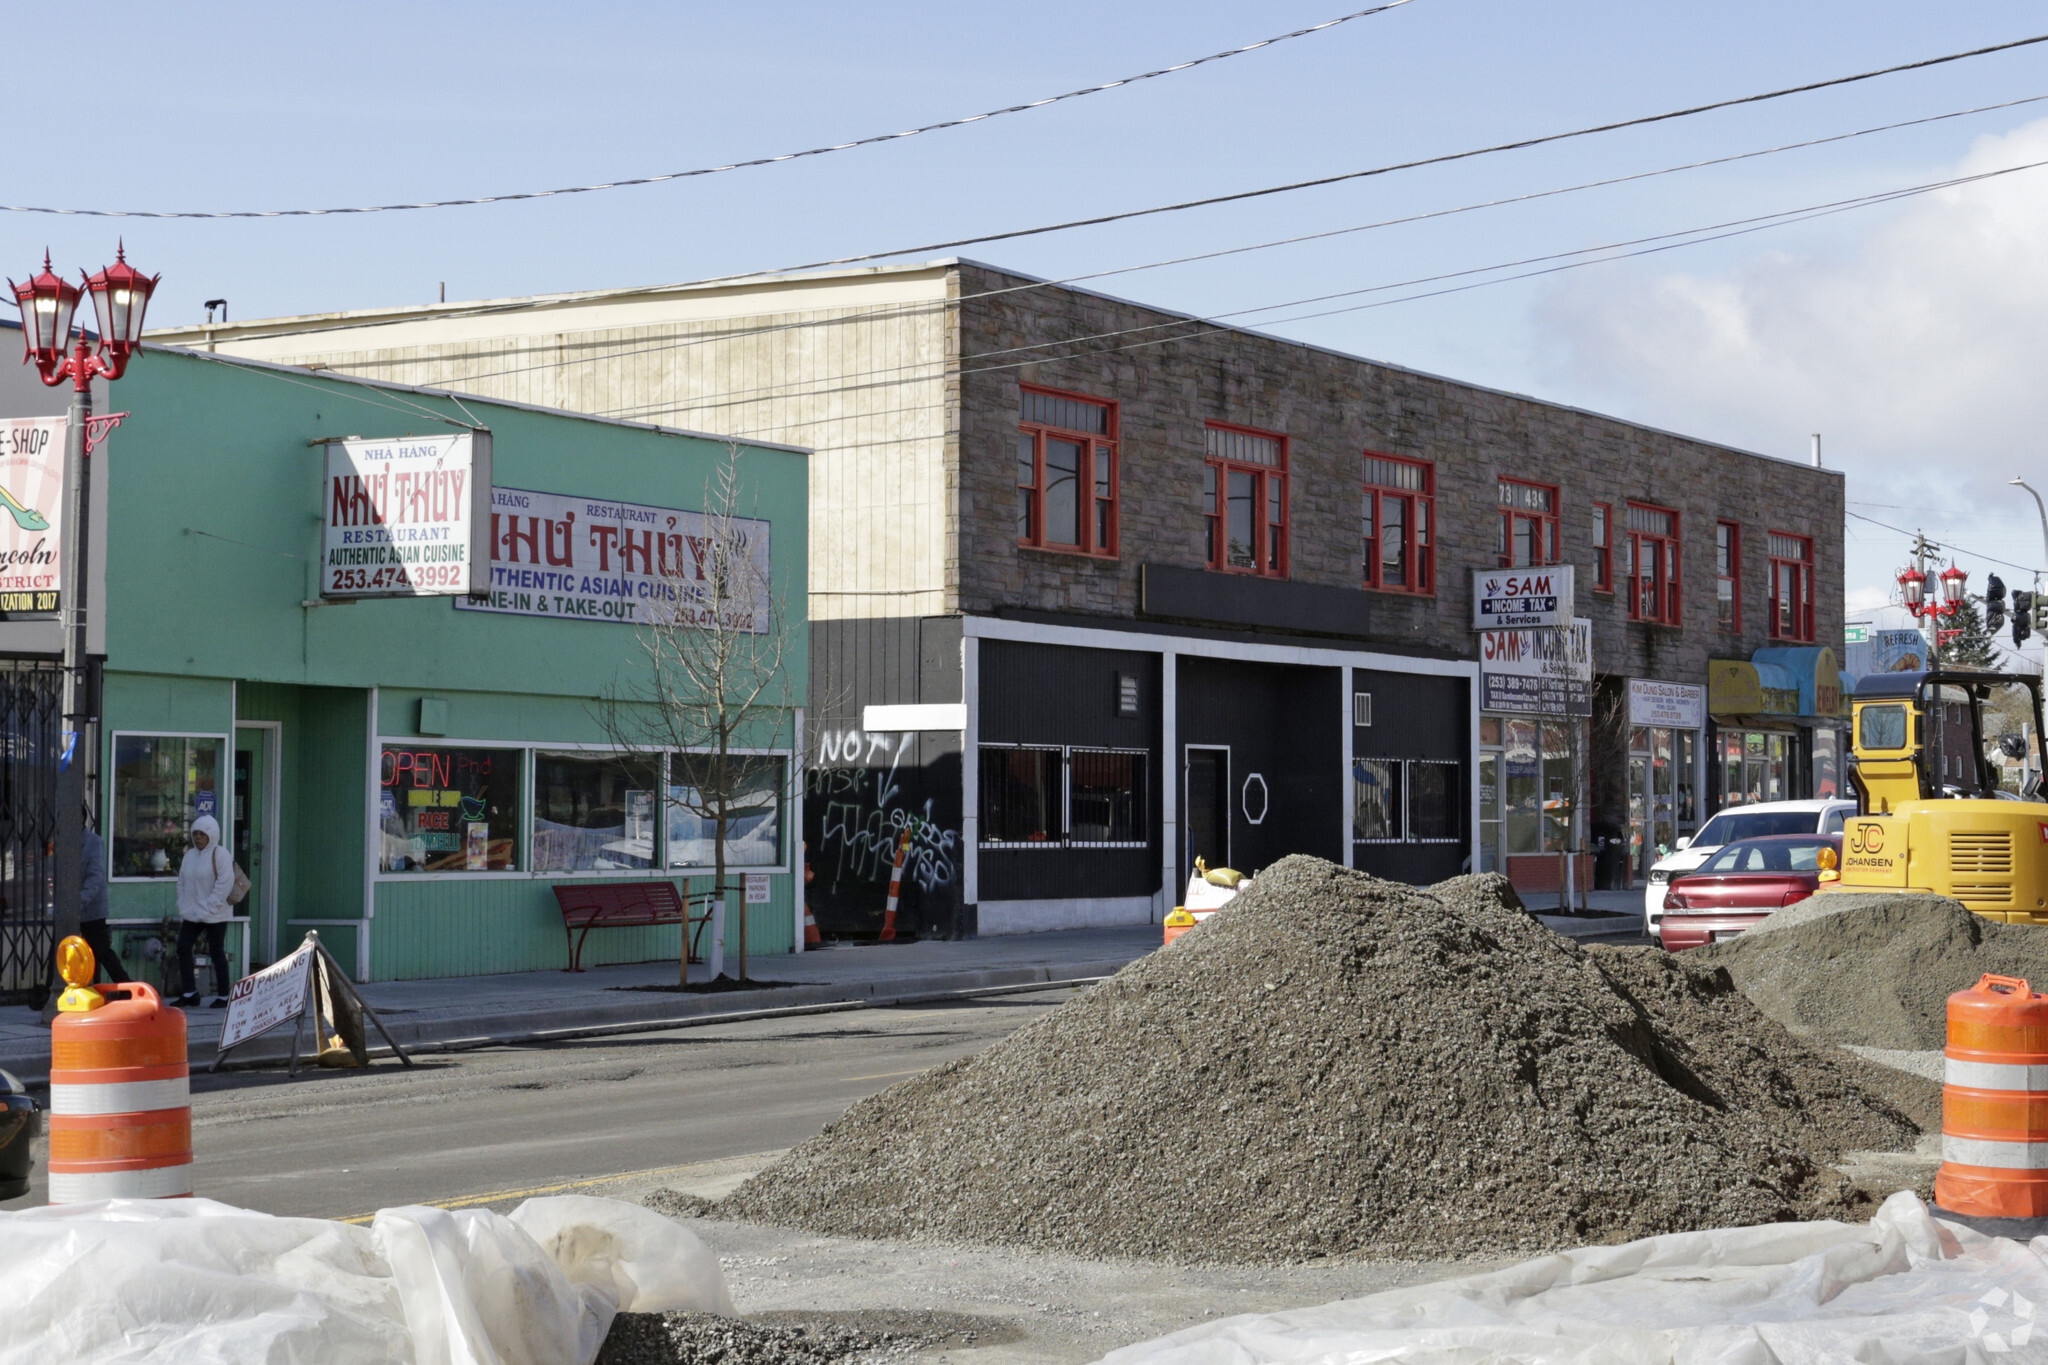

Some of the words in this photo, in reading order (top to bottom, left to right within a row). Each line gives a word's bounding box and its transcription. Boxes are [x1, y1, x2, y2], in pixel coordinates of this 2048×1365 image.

[365, 445, 393, 460] NHÀ
[399, 443, 437, 458] HÀNG
[586, 503, 658, 524] RESTAURANT
[343, 527, 450, 544] RESTAURANT
[329, 546, 386, 567] AUTHENTIC
[389, 545, 420, 565] ASIAN
[424, 543, 465, 563] CUISINE
[332, 565, 460, 590] 253.474.3992
[490, 567, 574, 592] THENTIC
[580, 576, 633, 598] ASIAN
[1505, 576, 1551, 596] SAM
[37, 592, 57, 610] 2017
[537, 595, 549, 611] &
[553, 597, 636, 619] TAKE-OUT
[1491, 599, 1525, 613] INCOME
[1530, 599, 1547, 612] TAX
[1497, 616, 1502, 625] &
[1506, 615, 1541, 625] Services
[1485, 632, 1521, 662] SAM
[1884, 633, 1919, 647] REFRESH
[1549, 662, 1577, 676] Servces
[1658, 685, 1674, 697] SALON
[1681, 687, 1699, 699] BARBER
[381, 751, 450, 788] OPEN
[418, 813, 449, 829] RICE
[1846, 858, 1893, 867] JOHANSEN
[232, 979, 253, 1000] NO
[257, 953, 306, 989] PARKING
[235, 996, 252, 1007] FROM
[232, 1020, 247, 1030] TOW
[253, 1008, 273, 1021] AWAY
[279, 993, 299, 1008] AREA
